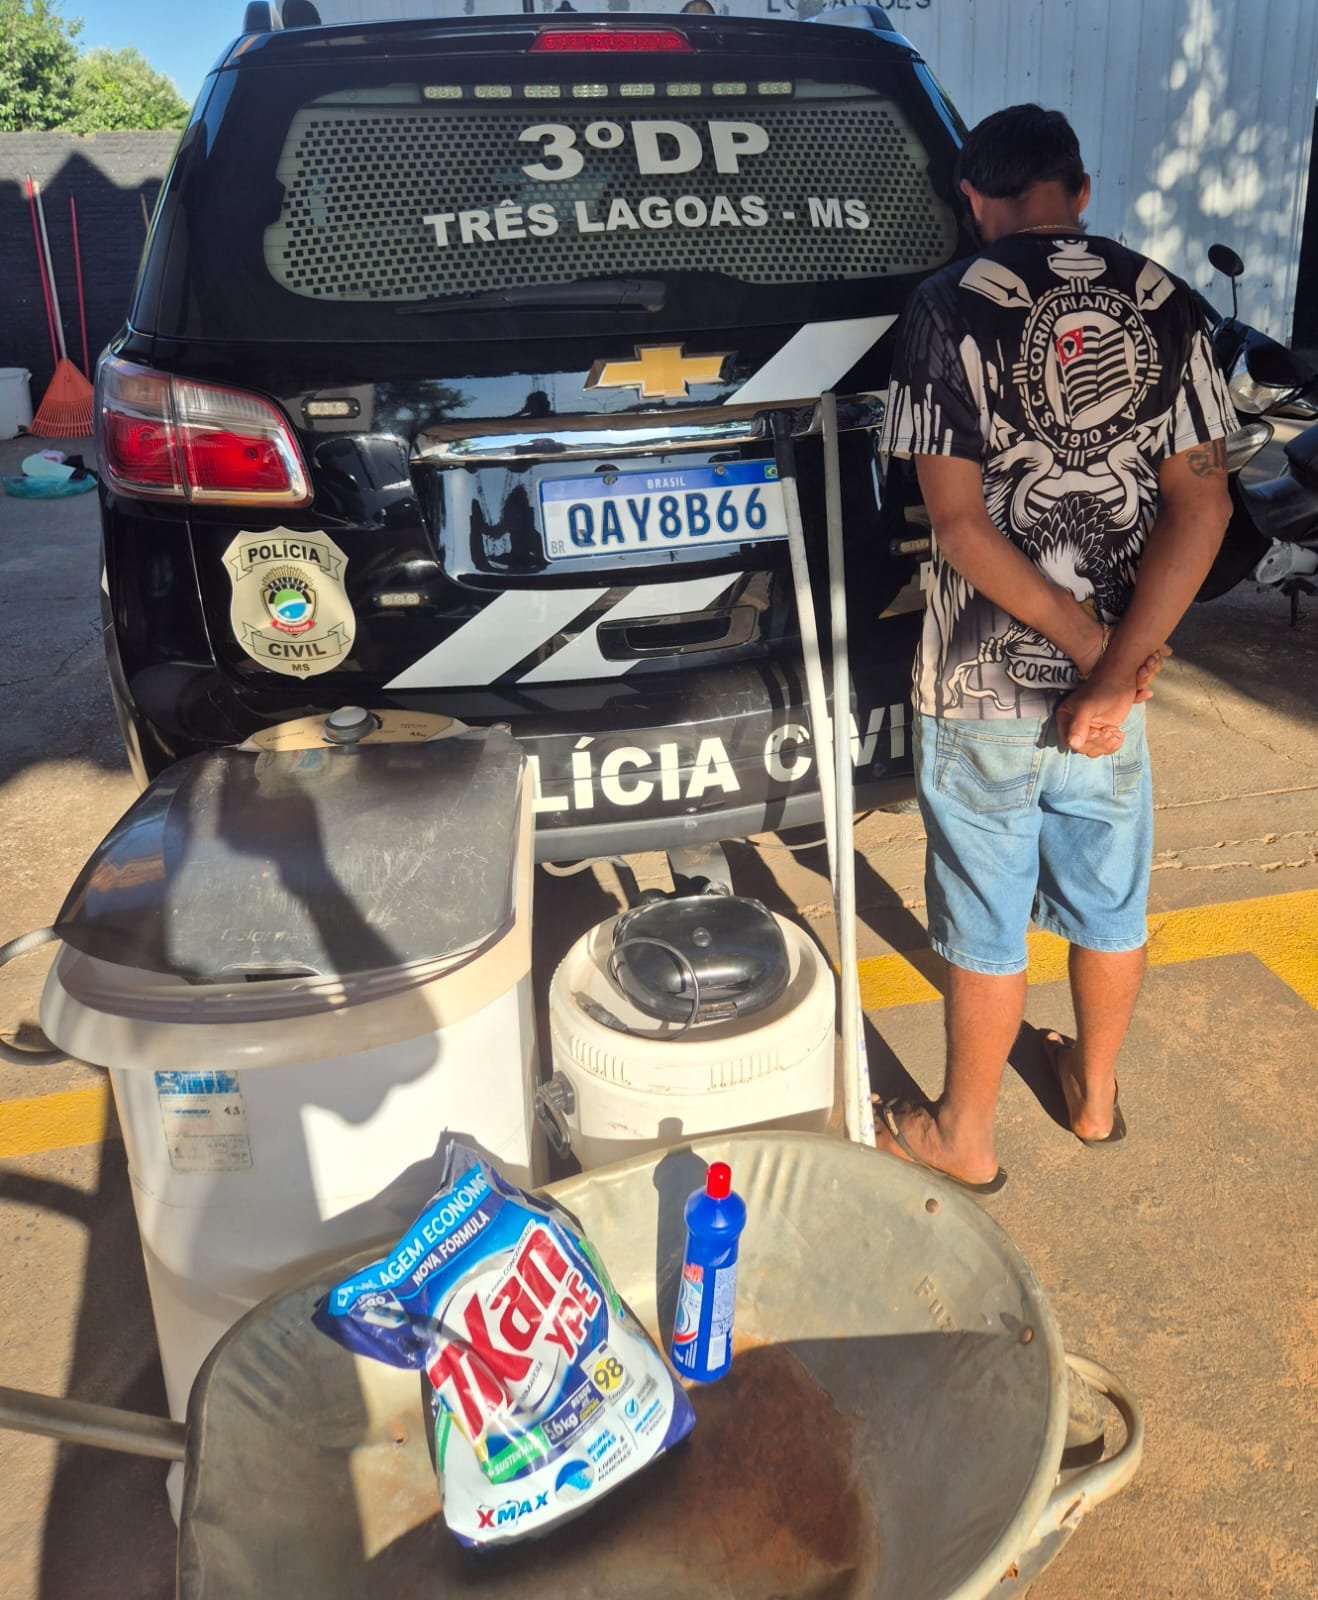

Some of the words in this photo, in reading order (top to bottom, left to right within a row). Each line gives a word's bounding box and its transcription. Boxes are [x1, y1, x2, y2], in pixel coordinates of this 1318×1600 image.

[423, 200, 559, 247] TRÊS
[575, 195, 769, 233] LAGOAS
[809, 198, 871, 230] MS
[1060, 429, 1102, 448] 1910
[647, 476, 686, 490] BRASIL
[567, 487, 768, 548] QAY8B66
[248, 540, 321, 563] POLÍCIA
[551, 541, 565, 554] BR
[268, 643, 327, 658] CIVIL
[292, 664, 310, 672] MS
[1012, 660, 1077, 683] CORINT
[529, 736, 740, 813] LÍCIA
[763, 703, 905, 783] CVI
[412, 1253, 442, 1286] NOVA
[594, 1357, 624, 1390] 98
[476, 1489, 549, 1529] XMAX
